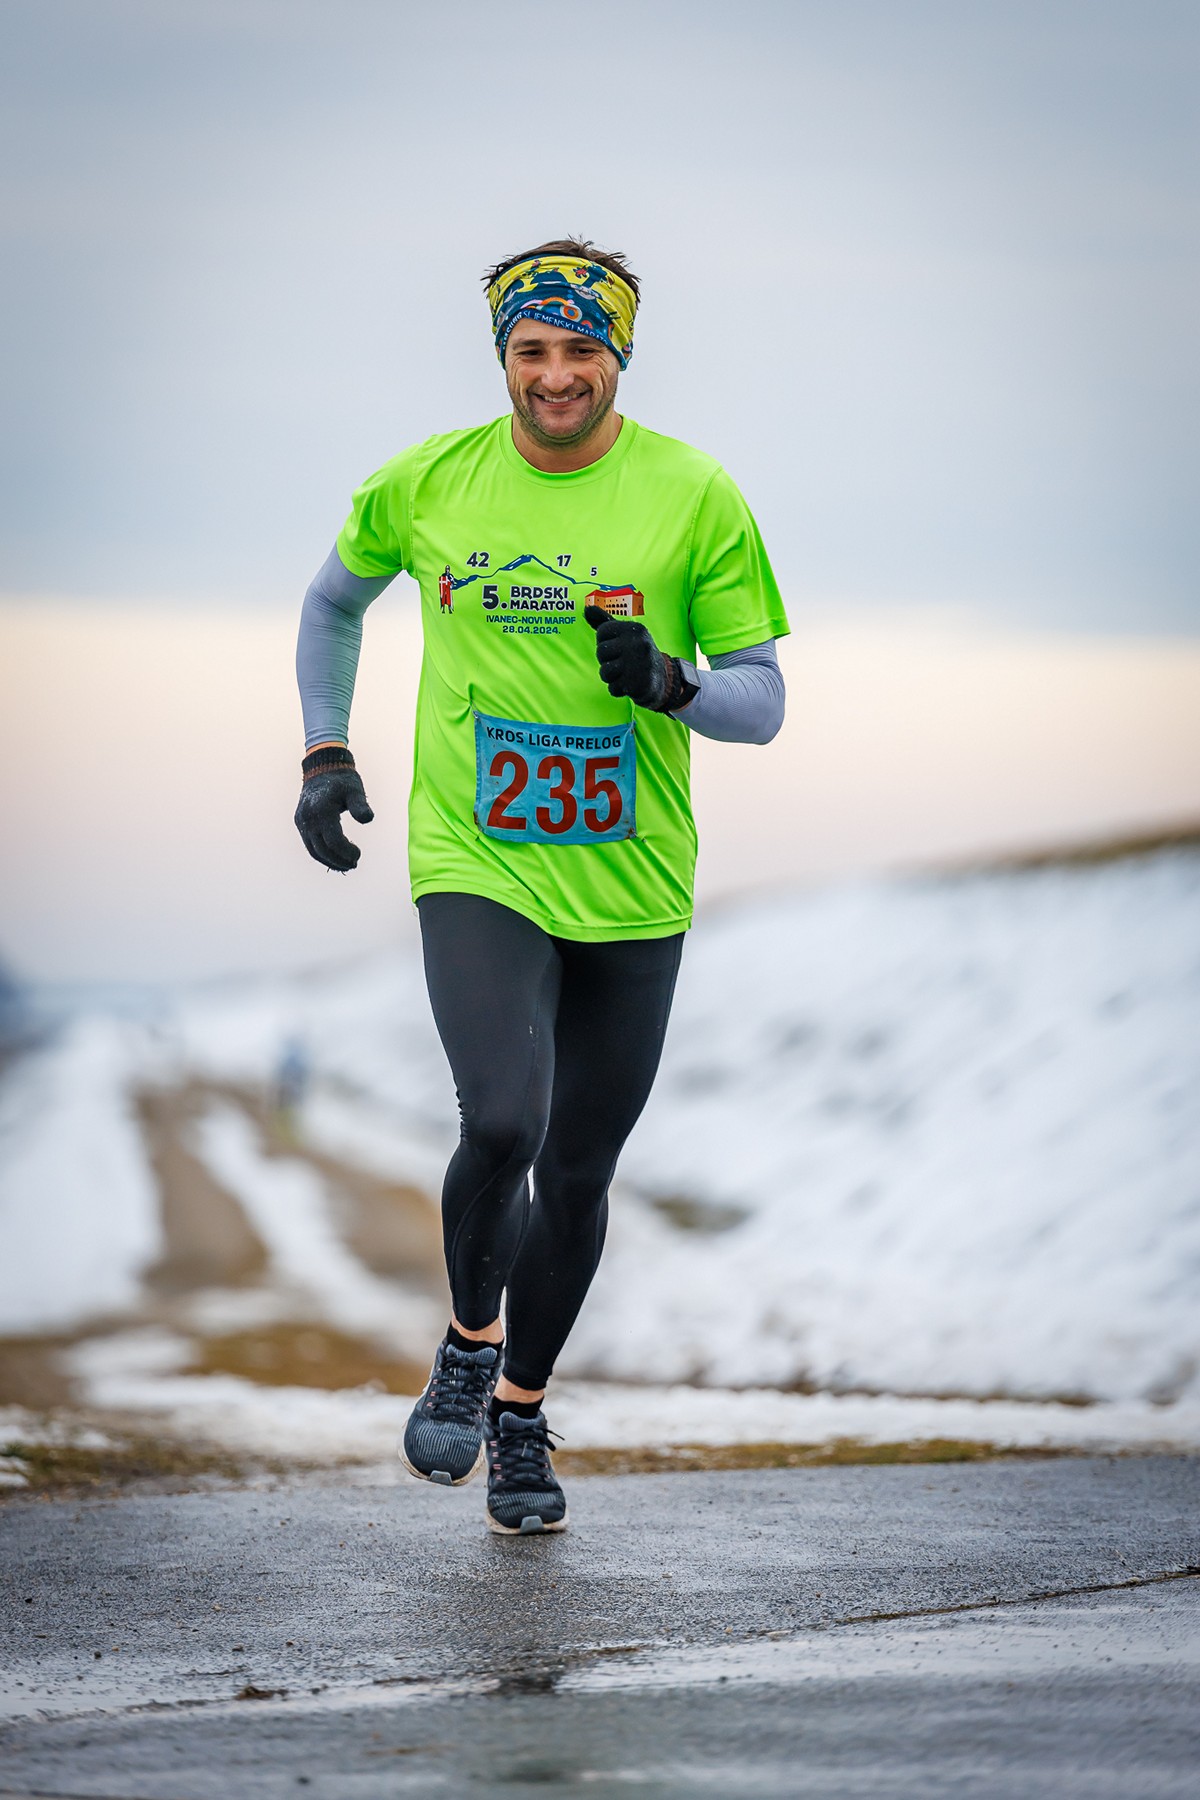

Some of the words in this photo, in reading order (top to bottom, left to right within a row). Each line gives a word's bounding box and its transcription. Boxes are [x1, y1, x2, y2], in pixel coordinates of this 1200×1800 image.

[466, 551, 490, 568] 42
[556, 554, 572, 567] 17
[590, 567, 598, 577] 5
[481, 584, 508, 610] 5.
[510, 585, 569, 600] BRDSKI
[509, 599, 576, 611] MARATON
[486, 614, 543, 625] IVANEC-NOVI
[544, 616, 577, 625] MAROF
[502, 625, 561, 635] 28.04.2024.
[486, 726, 524, 744] KROS
[528, 733, 562, 748] LIGA
[565, 735, 622, 750] PRELOG
[486, 750, 623, 835] 235
